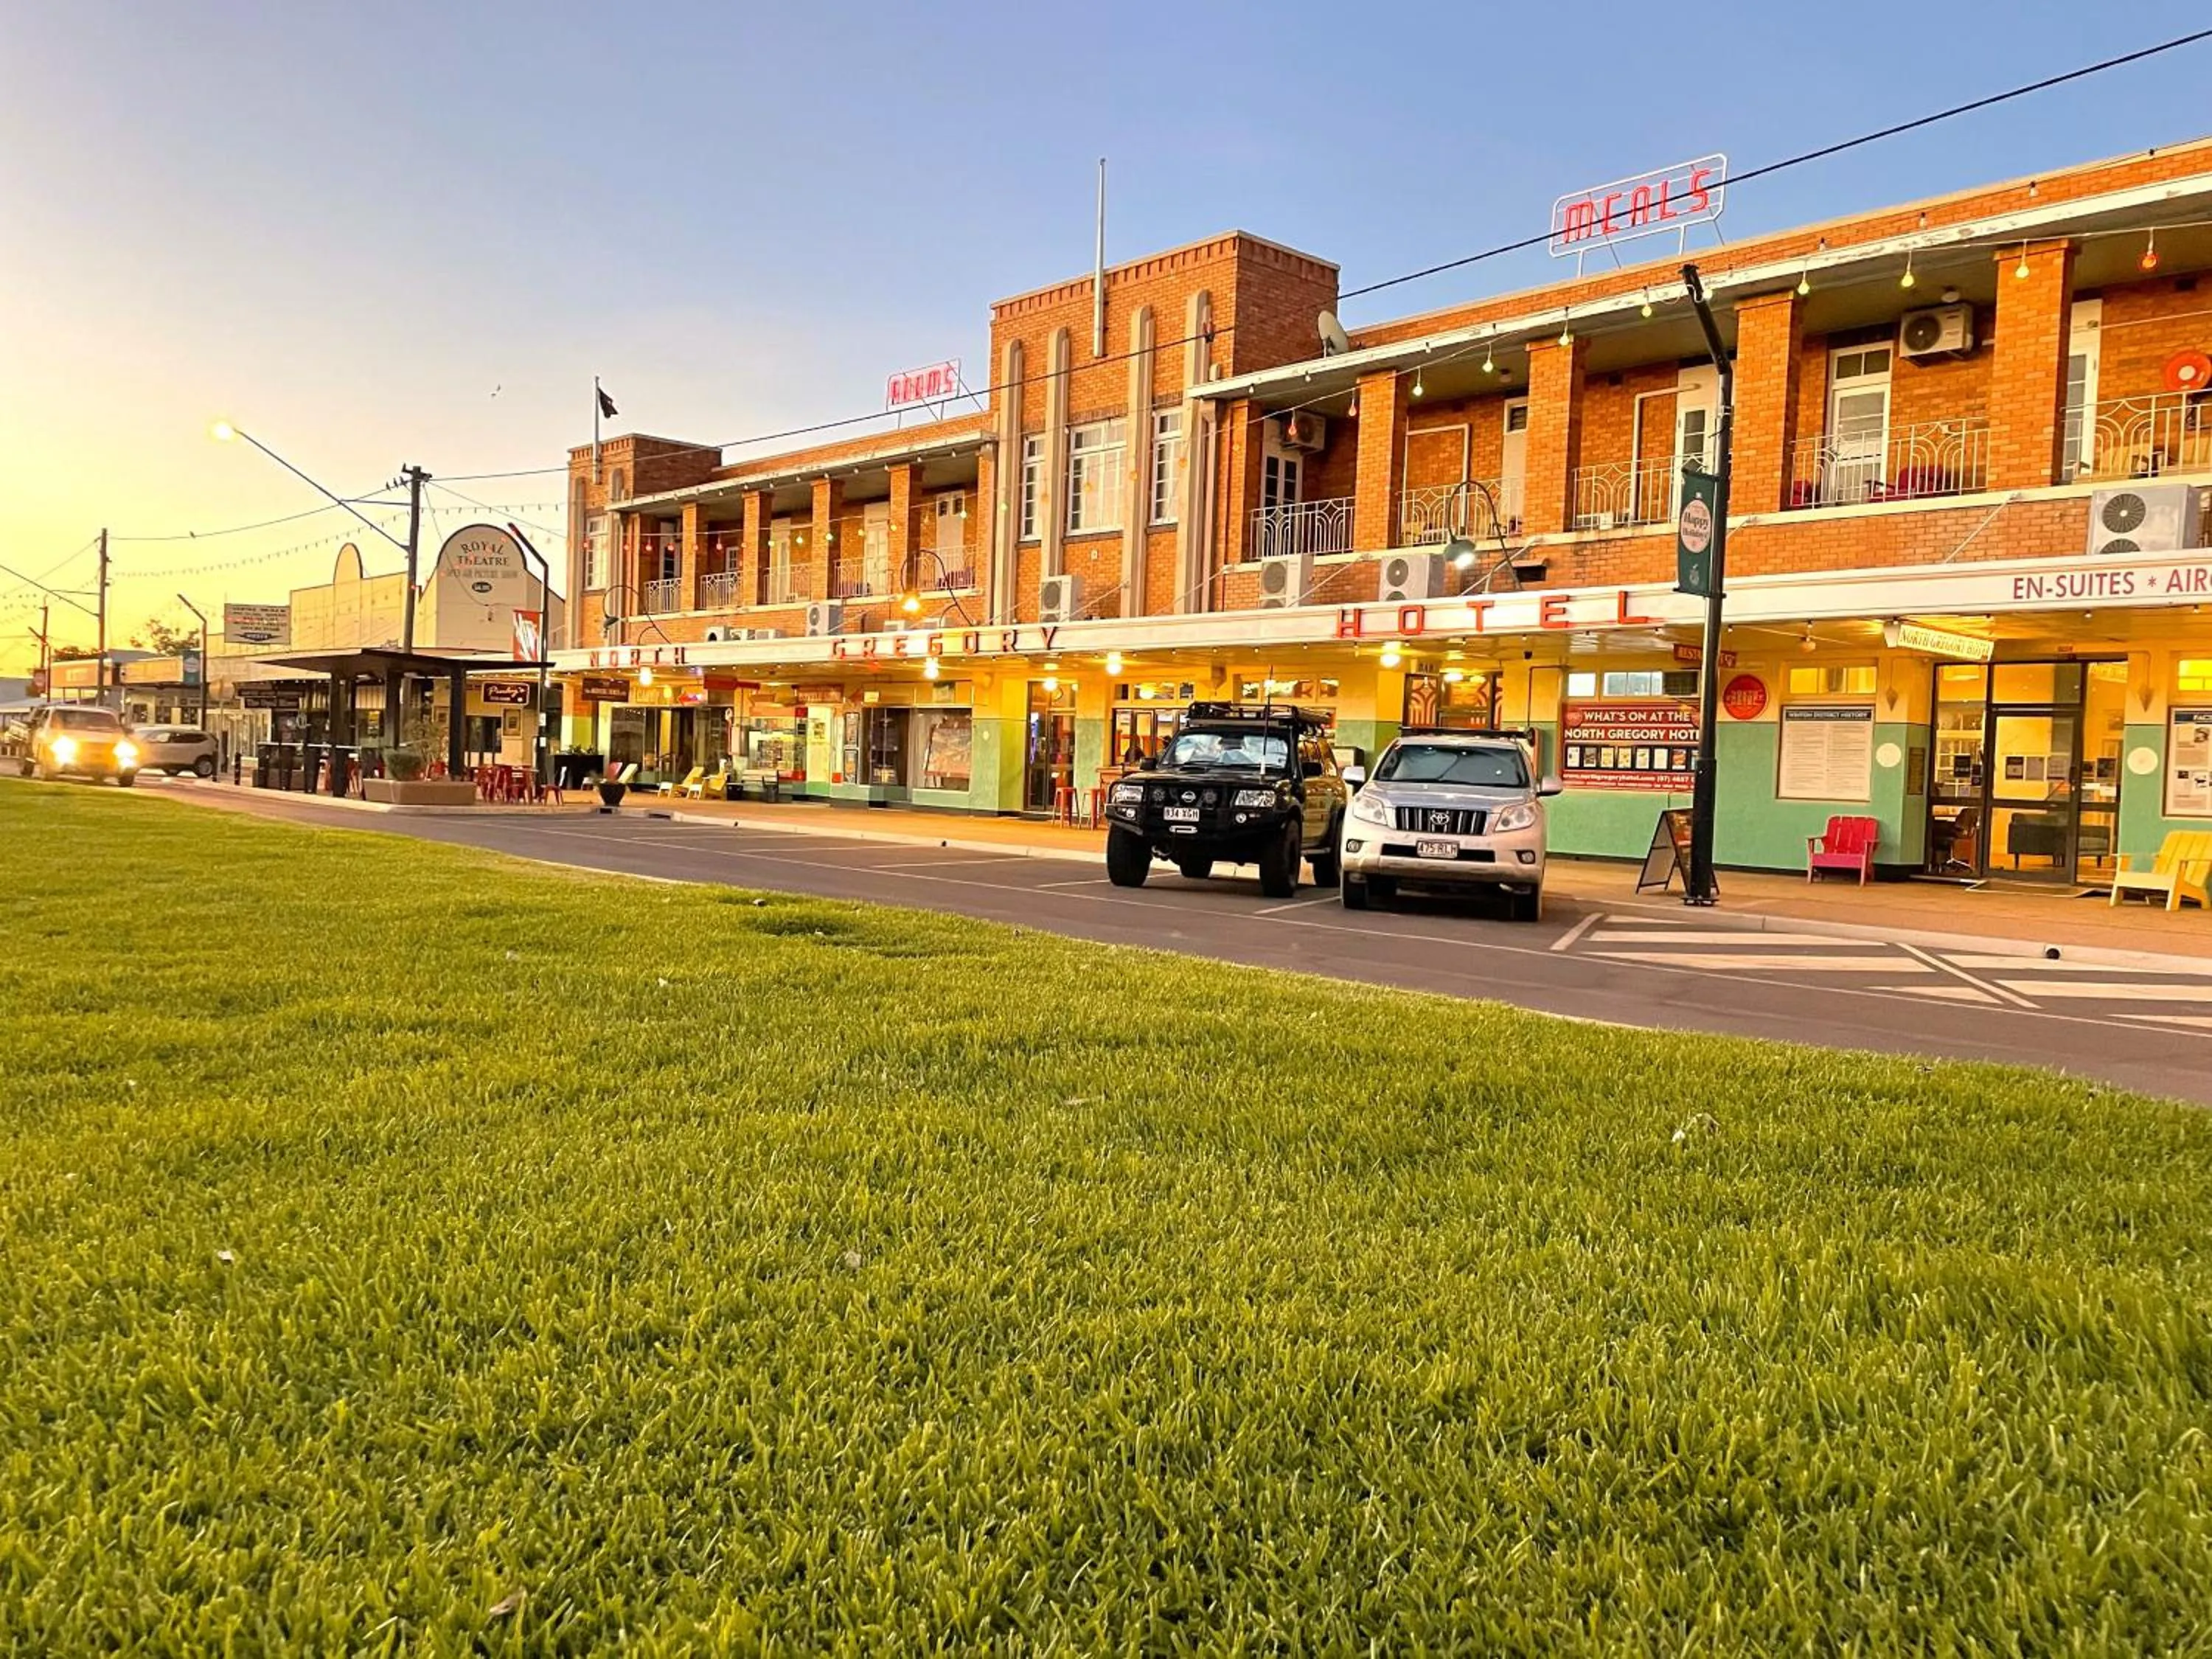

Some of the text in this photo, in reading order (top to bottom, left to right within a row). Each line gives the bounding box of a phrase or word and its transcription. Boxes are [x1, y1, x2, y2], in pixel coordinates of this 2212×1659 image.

[1564, 168, 1710, 243] MEALS
[1684, 512, 1708, 529] Happy
[460, 540, 504, 554] ROYAL
[457, 555, 509, 566] THEATRE
[2014, 568, 2212, 599] EN-SUITES AIR
[591, 591, 1649, 667] NORTH GREGORY HOTEL
[1585, 712, 1691, 722] WHAT'S ON AT THE
[1565, 729, 1699, 740] NORTH GREGORY HOT
